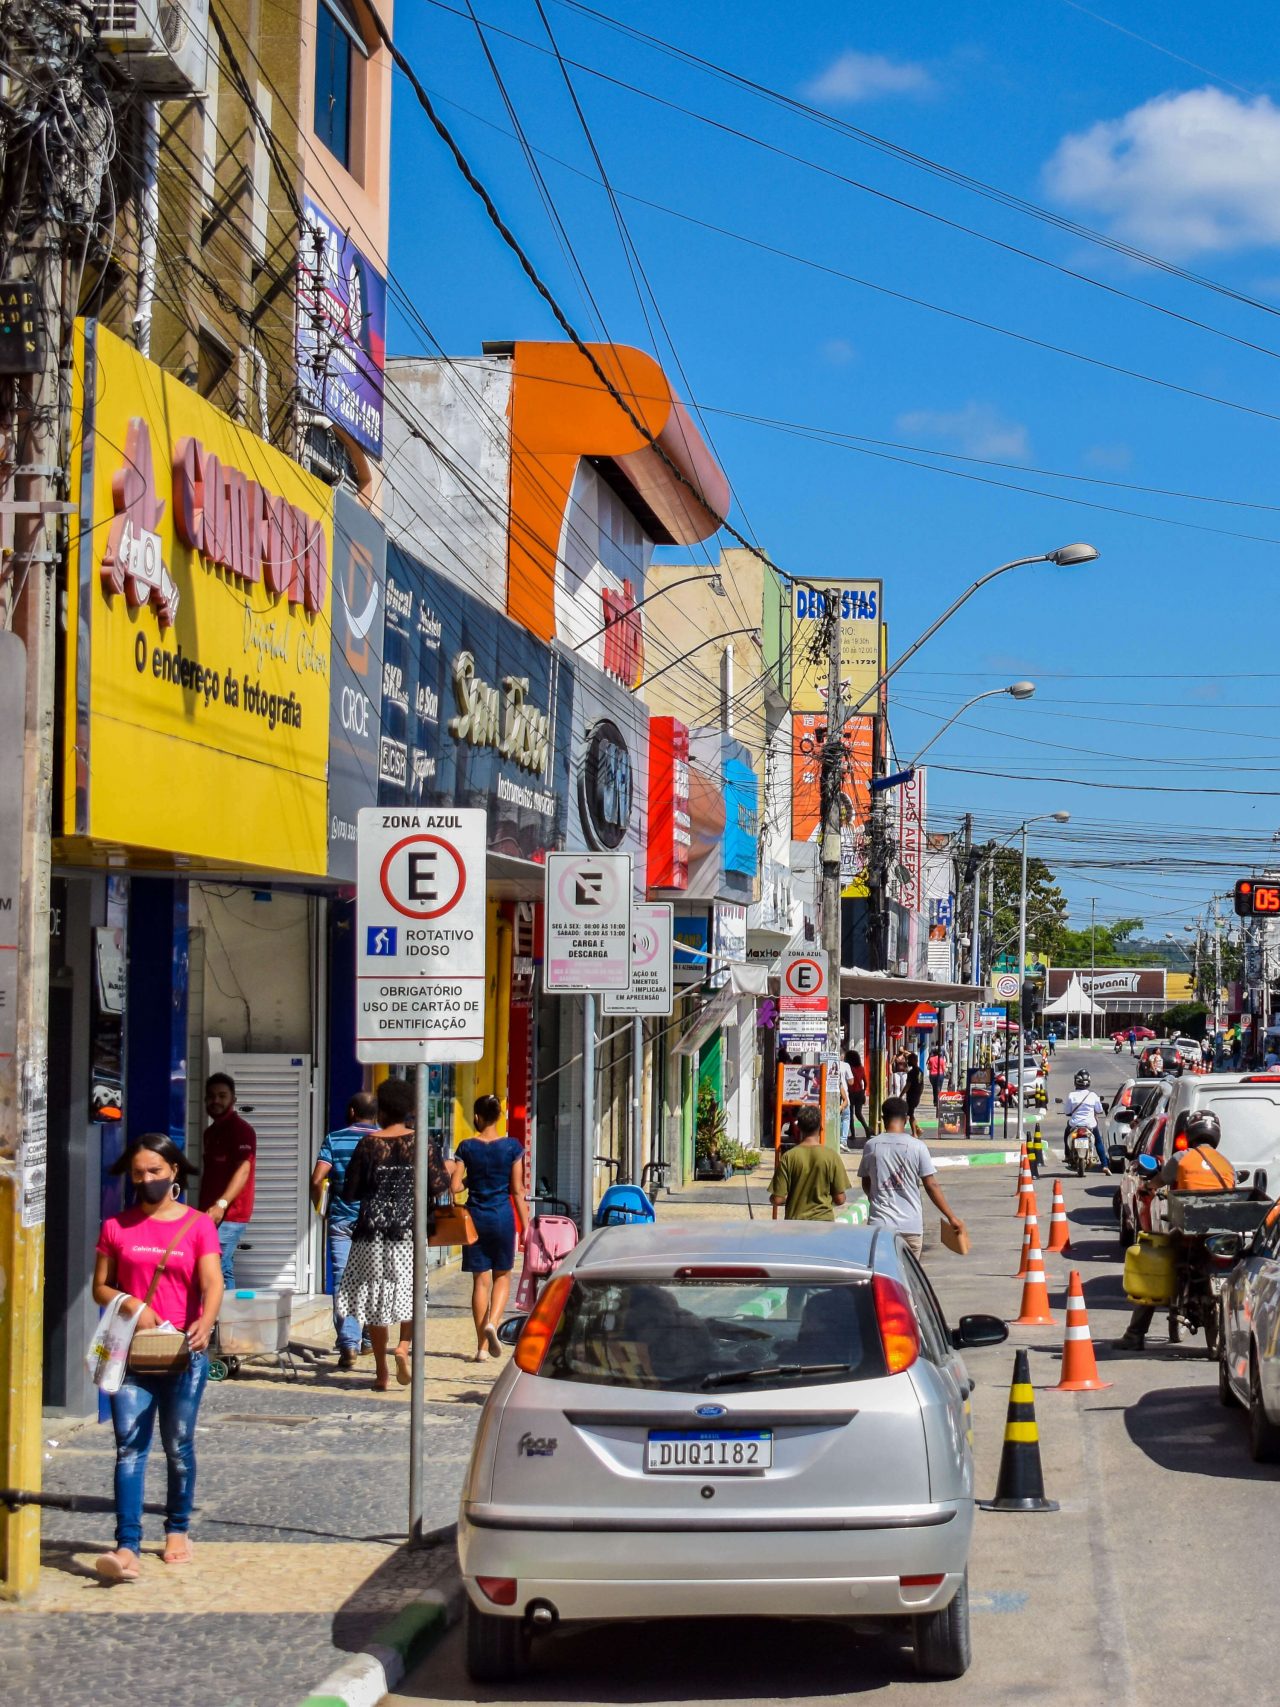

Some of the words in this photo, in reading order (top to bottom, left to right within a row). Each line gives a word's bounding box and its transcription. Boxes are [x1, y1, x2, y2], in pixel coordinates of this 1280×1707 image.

[796, 590, 877, 620] DENSTAS
[135, 630, 148, 673] O
[152, 644, 219, 707] endereço
[223, 667, 239, 707] da
[243, 674, 302, 731] fotografia
[341, 686, 369, 738] CROE
[382, 815, 420, 828] ZONA
[427, 815, 462, 828] AZUL
[408, 851, 438, 900] E
[1255, 888, 1280, 910] 05
[406, 929, 474, 940] ROTATIVO
[406, 945, 450, 956] IDOSO
[568, 950, 608, 958] DESCARGA
[798, 966, 811, 988] E
[1082, 976, 1129, 993] giovanni
[379, 983, 463, 996] OBRIGATÓRIO
[363, 1002, 388, 1012] USO
[392, 1002, 408, 1012] DE
[411, 999, 460, 1012] CARTÃO
[463, 1001, 479, 1011] DE
[379, 1016, 466, 1031] DENTIFICAÇÃO
[660, 1442, 760, 1465] DUQ1I82
